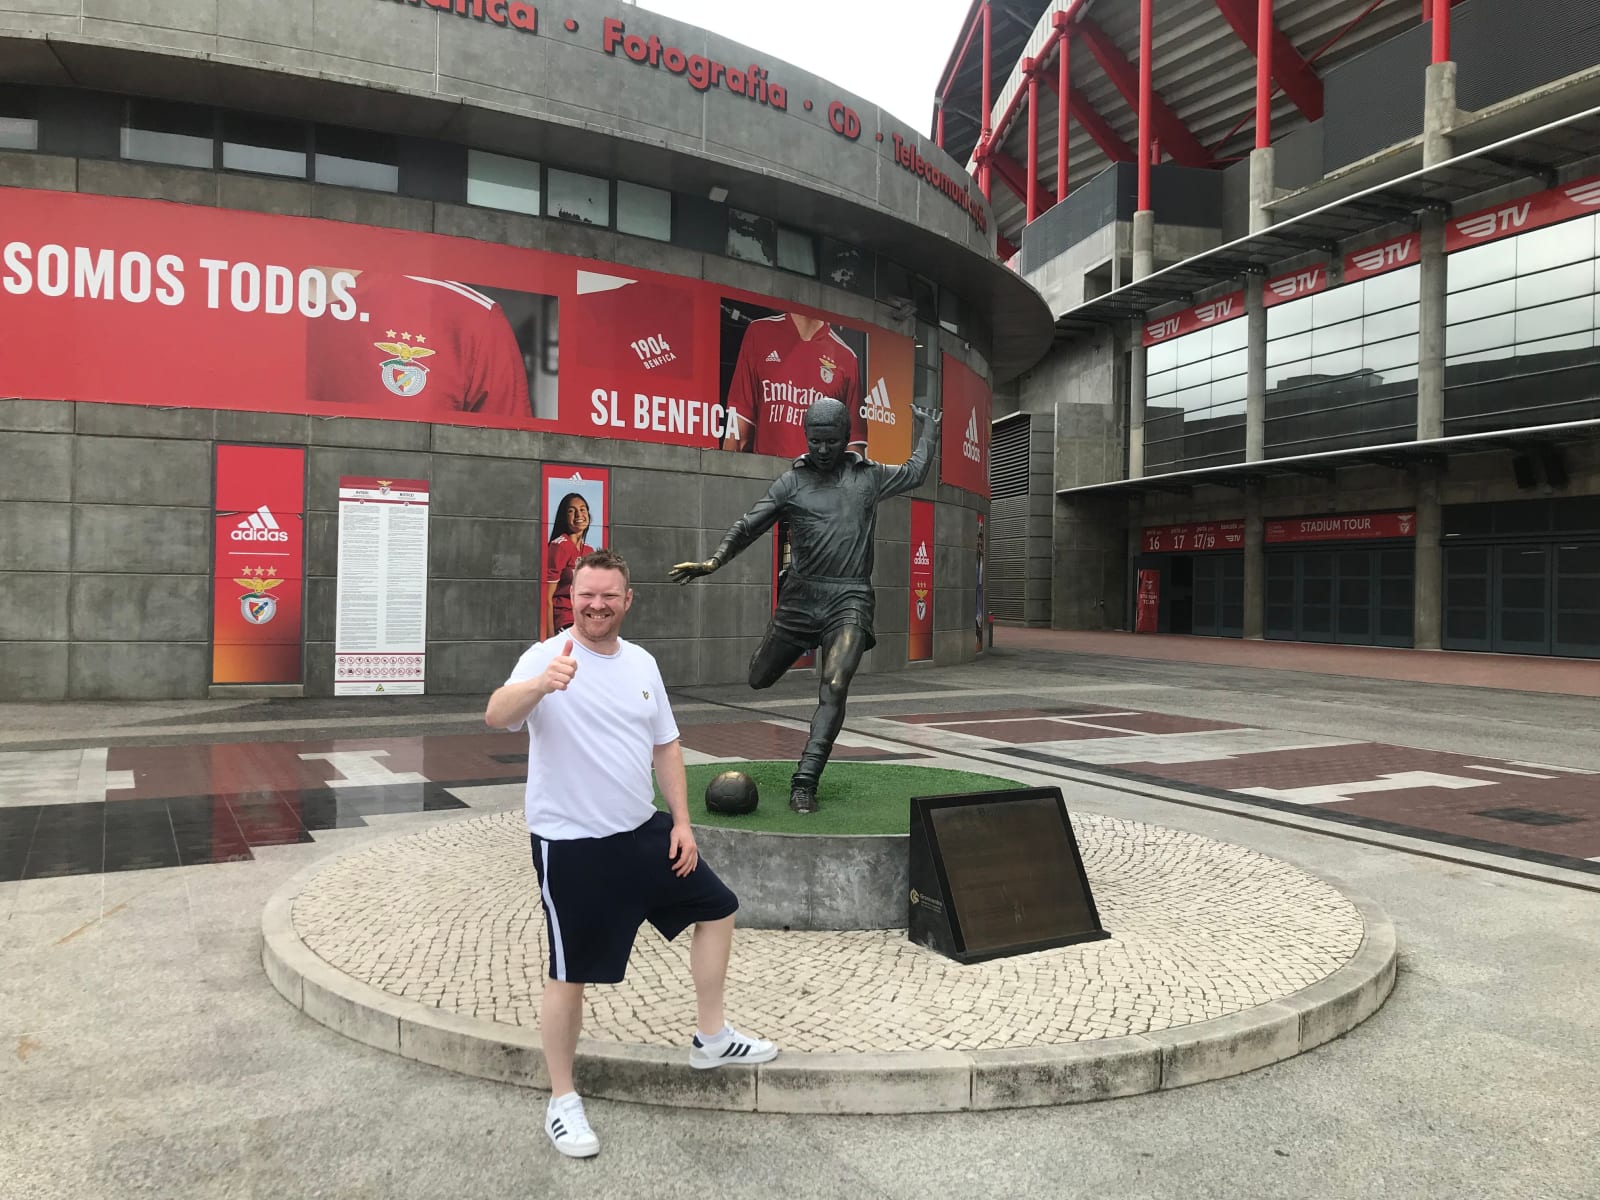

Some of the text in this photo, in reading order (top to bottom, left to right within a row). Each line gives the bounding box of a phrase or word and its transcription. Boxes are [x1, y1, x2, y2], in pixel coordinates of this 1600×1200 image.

[603, 17, 787, 109] Fotografia
[828, 101, 861, 139] CD
[1455, 202, 1531, 237] BTV
[1352, 239, 1412, 271] BTV
[3, 241, 370, 322] SOMOS TODOS.
[1269, 268, 1319, 297] BTV
[1194, 298, 1233, 323] BTV
[630, 333, 671, 360] 1904
[643, 352, 677, 370] BENFICA
[762, 379, 828, 405] Emirate
[590, 388, 740, 441] SL BENFICA
[769, 404, 808, 427] FLY BET
[859, 405, 896, 425] adidas
[963, 440, 981, 463] adidas
[231, 527, 289, 542] adidas
[1300, 519, 1341, 533] STADIUM
[1343, 518, 1371, 530] TOUR
[1149, 535, 1160, 551] 16
[1174, 534, 1185, 549] 17
[1193, 533, 1216, 550] 17/19
[913, 555, 930, 565] adidas
